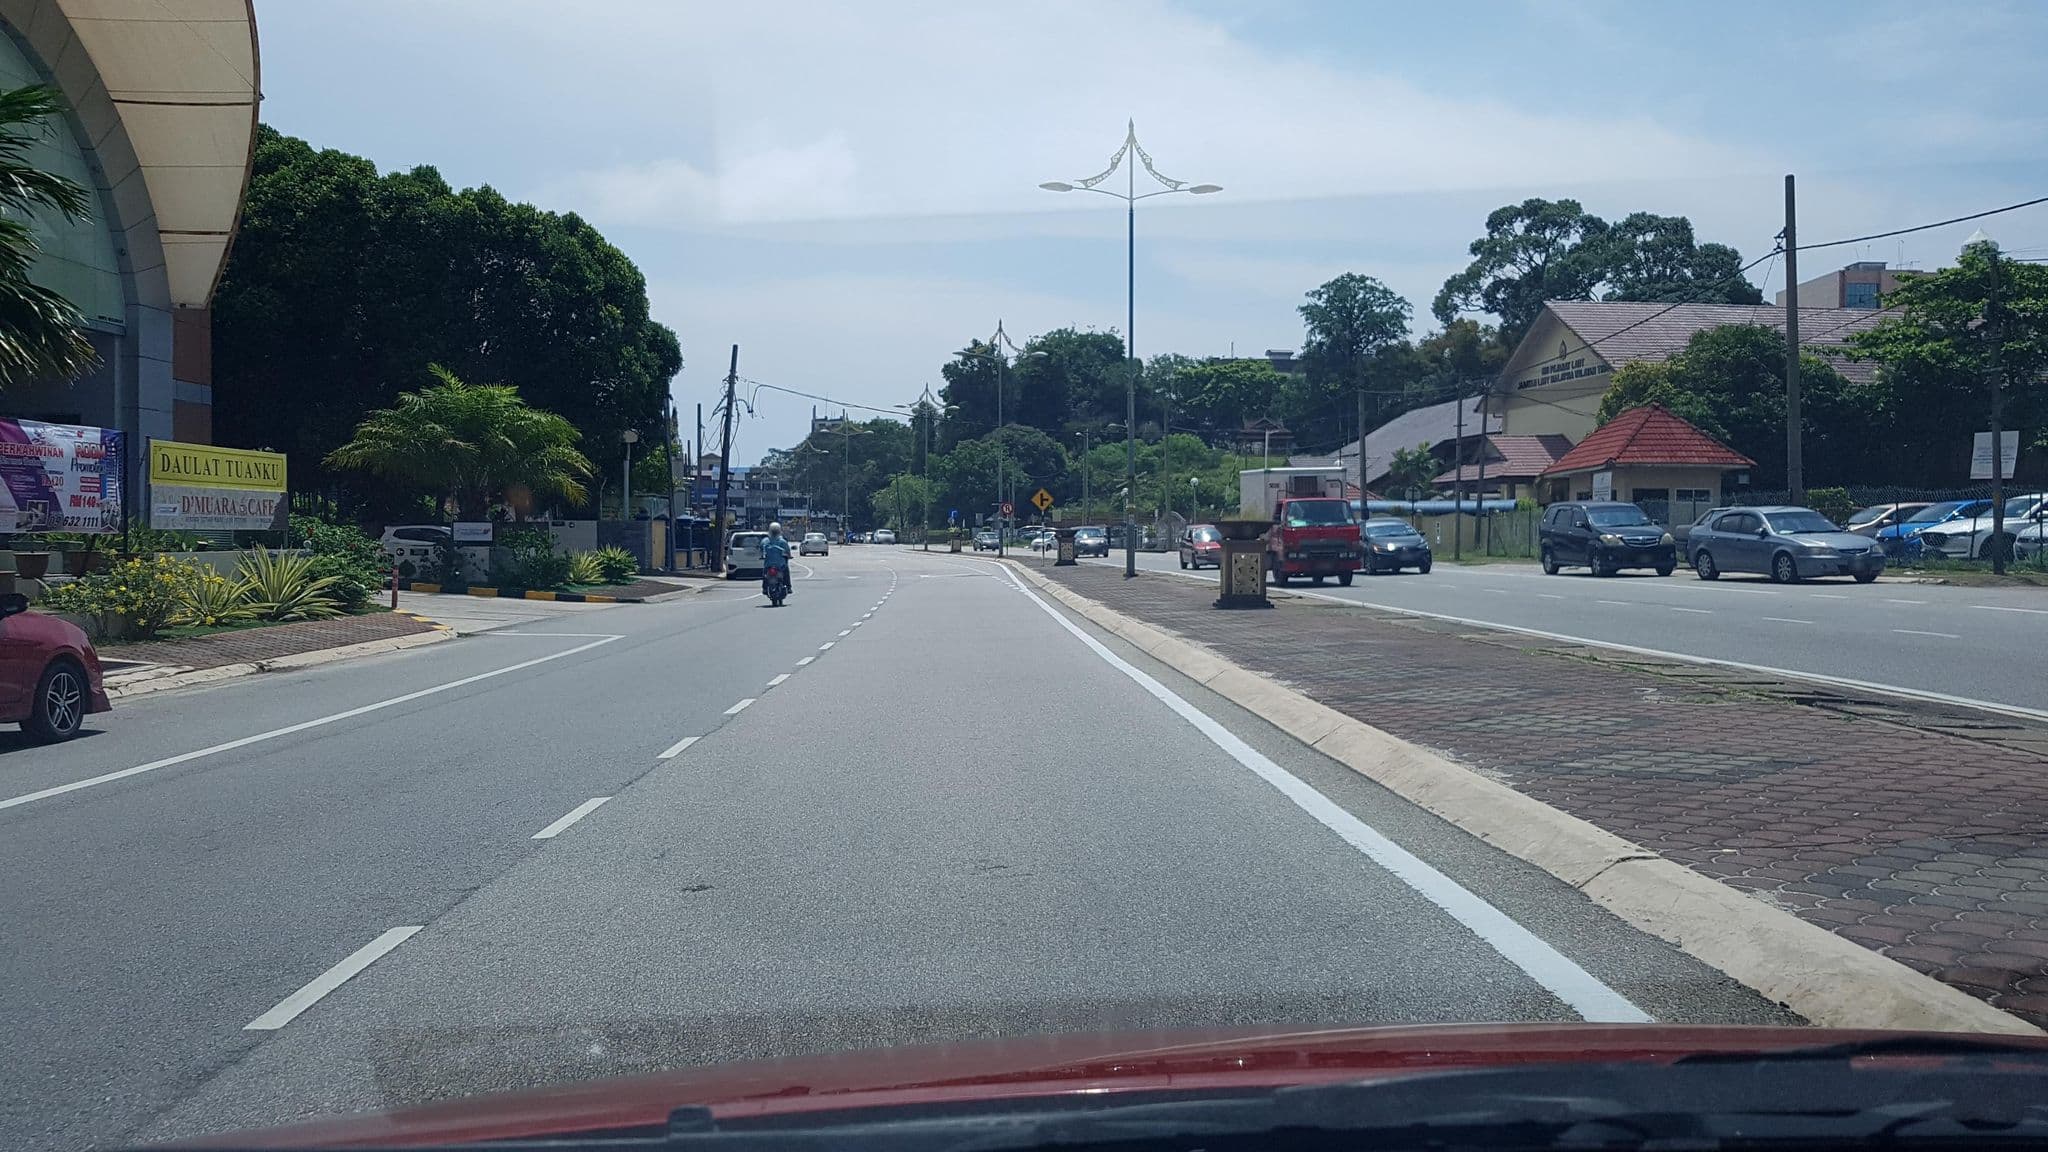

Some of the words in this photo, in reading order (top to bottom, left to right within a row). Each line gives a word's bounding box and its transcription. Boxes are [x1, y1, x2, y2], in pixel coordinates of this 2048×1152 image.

[74, 441, 106, 459] ROOM
[161, 453, 220, 476] DAULAT
[225, 459, 279, 481] TUANKU
[182, 495, 237, 514] D'MUARA
[62, 515, 81, 527] 632
[82, 516, 99, 527] 1111
